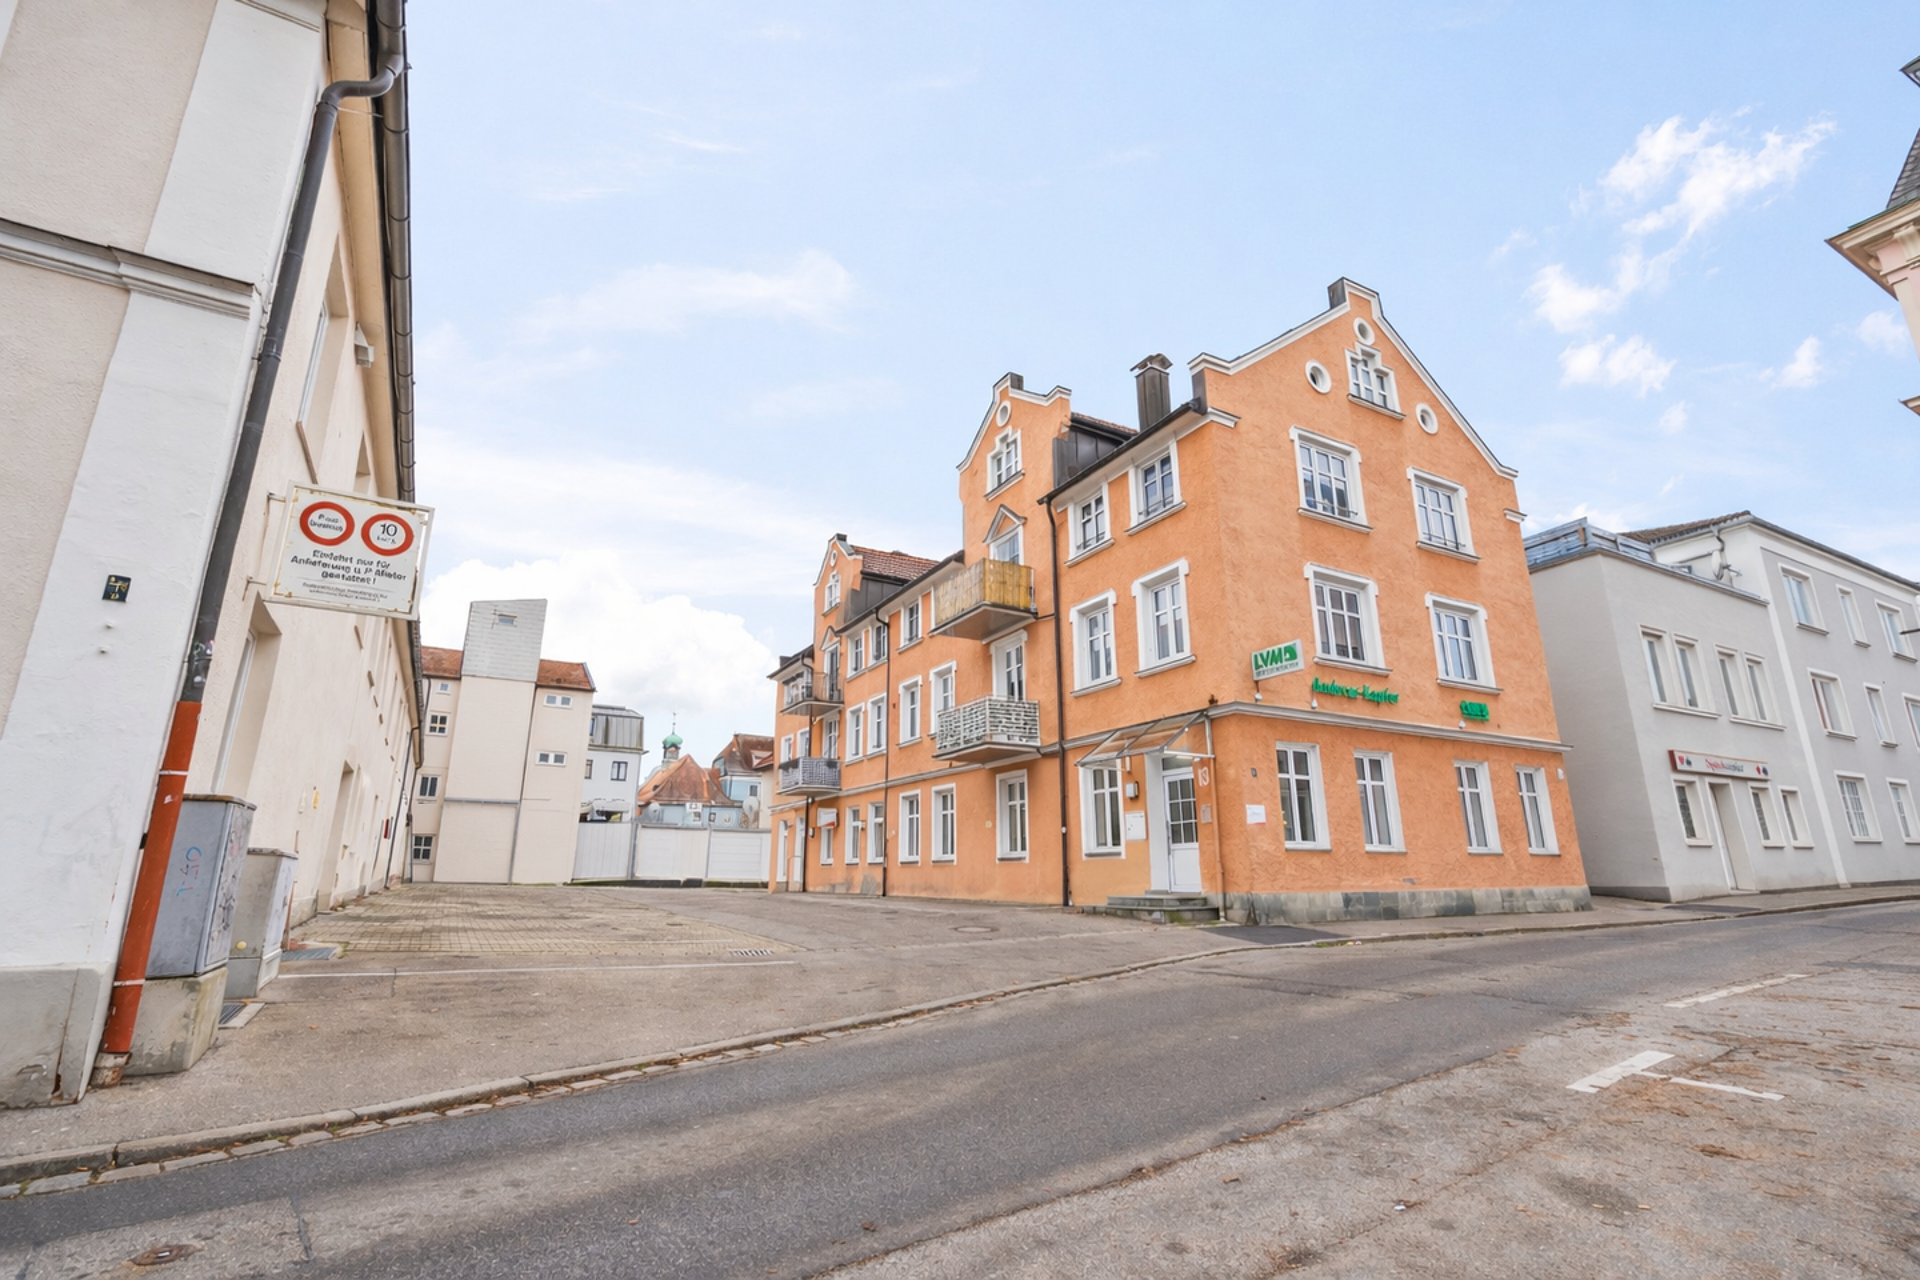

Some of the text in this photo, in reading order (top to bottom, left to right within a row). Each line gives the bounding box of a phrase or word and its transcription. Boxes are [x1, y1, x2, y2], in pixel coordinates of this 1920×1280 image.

[380, 523, 398, 537] 10
[376, 559, 391, 569] für
[1254, 647, 1284, 671] LVM
